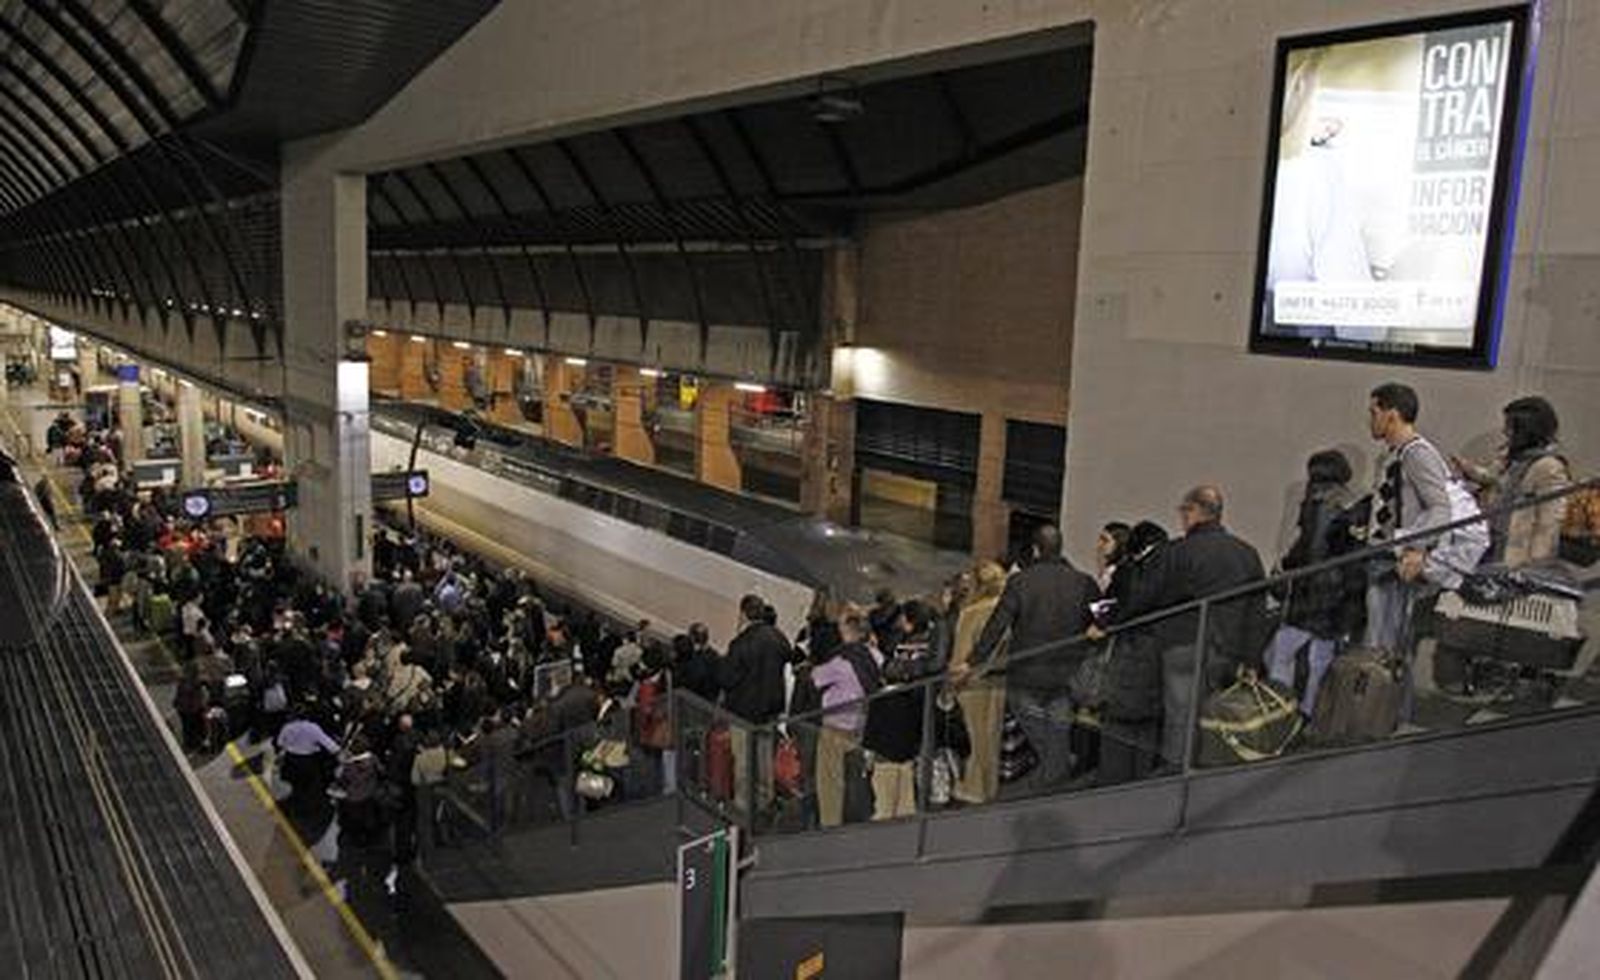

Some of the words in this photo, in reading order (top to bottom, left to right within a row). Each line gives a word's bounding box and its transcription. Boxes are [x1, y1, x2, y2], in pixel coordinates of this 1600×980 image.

[1426, 38, 1498, 91] CON
[1422, 91, 1491, 137] TRA
[1412, 177, 1486, 206] INFOR
[685, 868, 695, 890] 3
